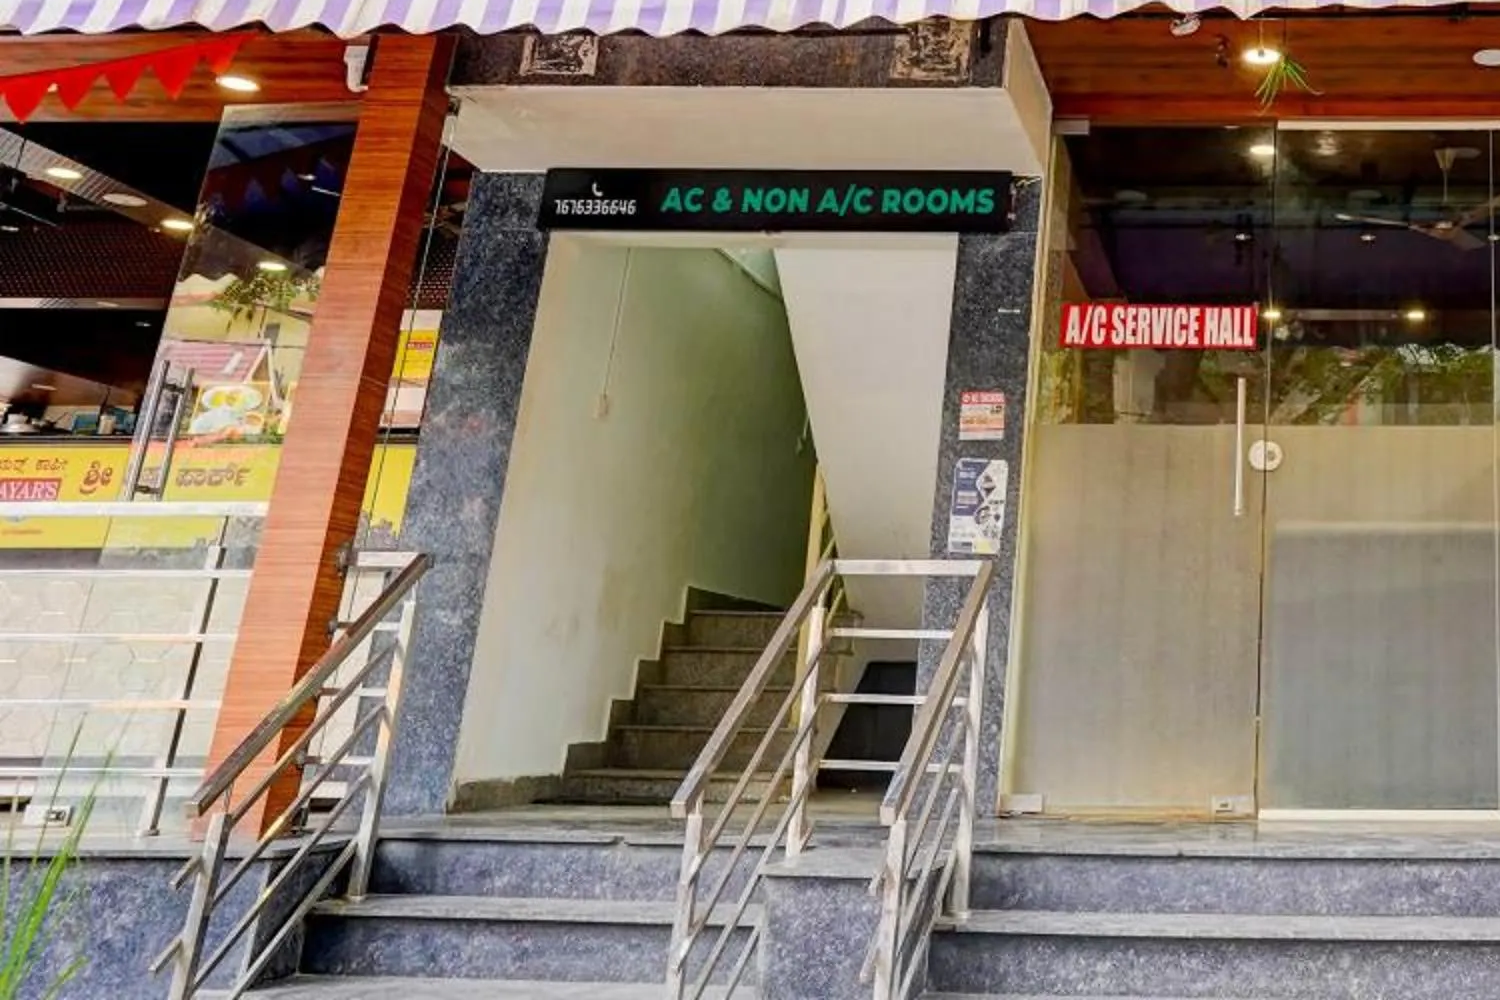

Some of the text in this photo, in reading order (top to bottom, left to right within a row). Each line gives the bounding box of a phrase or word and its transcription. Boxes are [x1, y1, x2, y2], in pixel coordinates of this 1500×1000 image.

[660, 187, 705, 214] AC
[711, 187, 733, 214] &
[741, 187, 814, 214] NON
[816, 183, 877, 217] A/C
[881, 187, 995, 215] ROOMS
[1064, 304, 1256, 346] A/C SERVICE HALL
